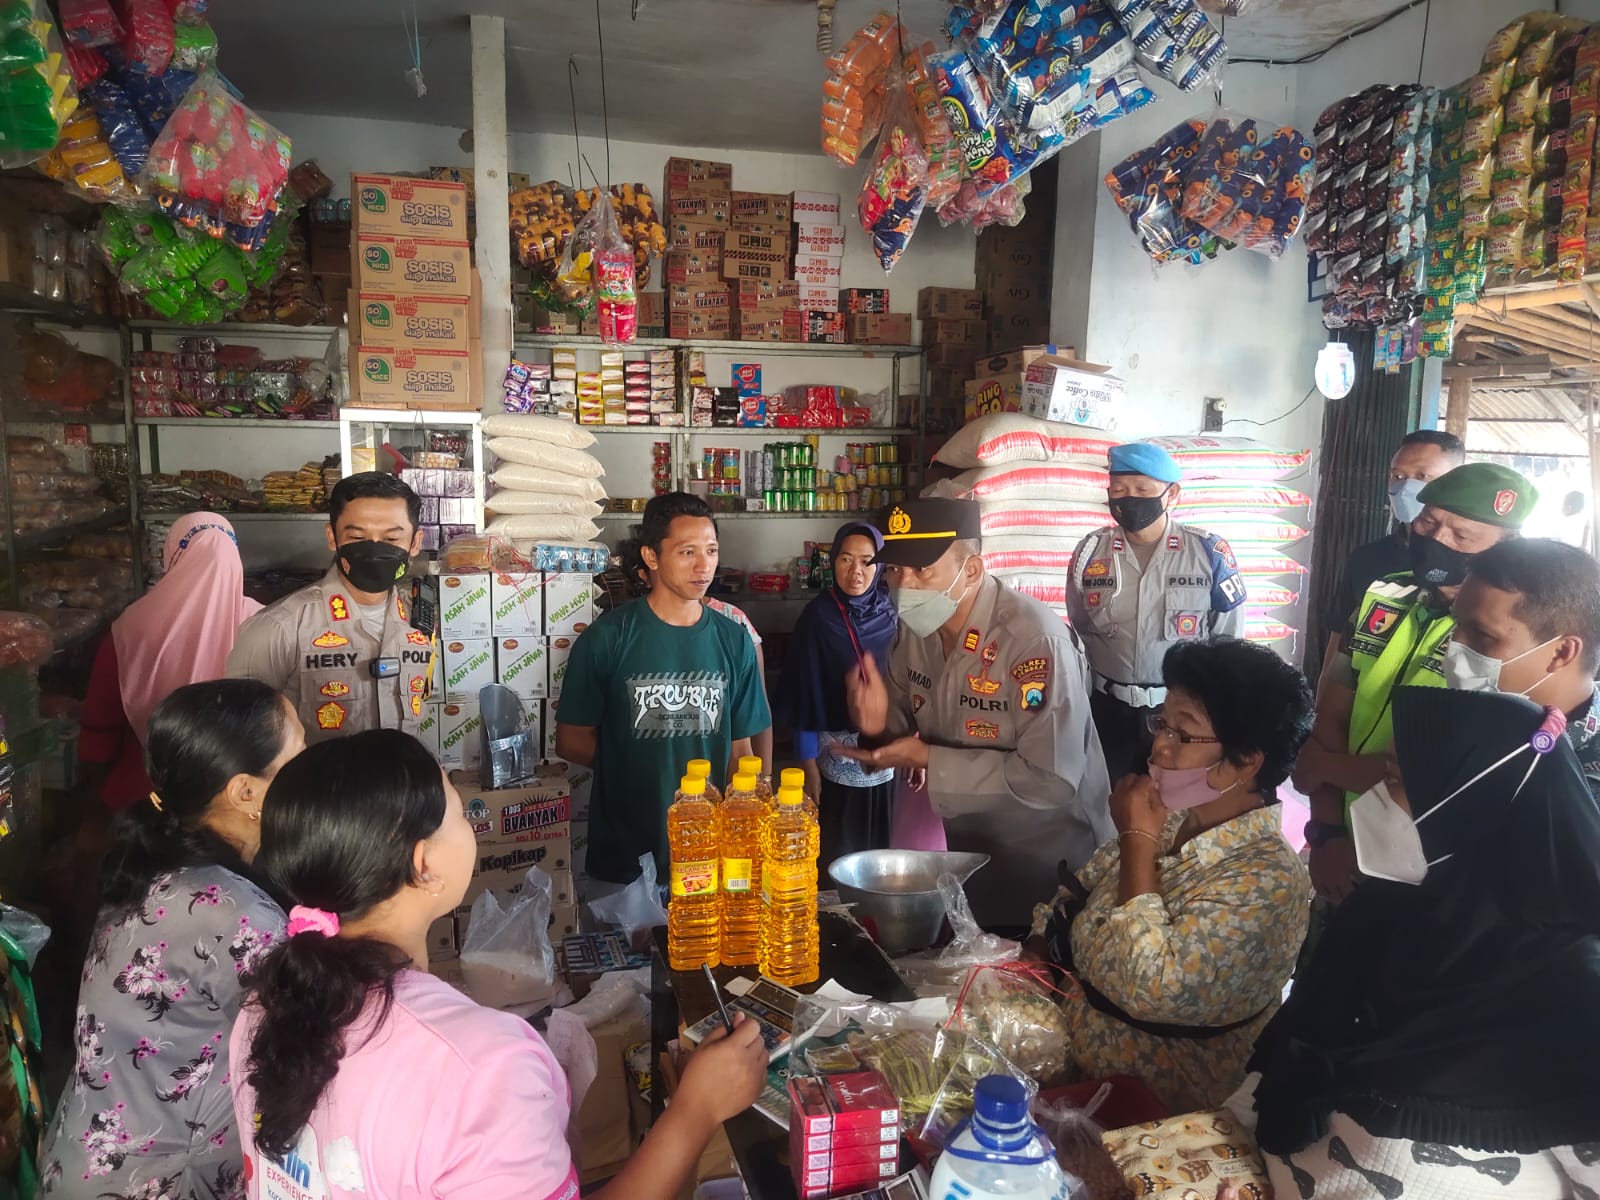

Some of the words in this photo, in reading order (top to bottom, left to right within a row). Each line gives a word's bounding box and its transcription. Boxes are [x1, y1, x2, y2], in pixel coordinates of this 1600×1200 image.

[361, 190, 377, 201] SO
[403, 202, 451, 218] SOSIS
[421, 216, 453, 227] makan
[366, 249, 380, 259] SO
[407, 260, 455, 275] SOSIS
[425, 272, 456, 283] makan
[367, 306, 380, 316] SO
[407, 317, 454, 331] SOSIS
[404, 329, 423, 339] siap
[425, 328, 456, 339] makan
[366, 360, 379, 370] SO
[406, 371, 453, 384] SOSIS
[424, 382, 455, 392] makan
[977, 383, 1000, 406] RING
[1065, 385, 1089, 398] Coffee
[980, 398, 1001, 417] GO
[1169, 577, 1209, 587] POLRI
[444, 603, 466, 623] ASAM
[466, 587, 487, 606] JAWA
[495, 600, 516, 621] ASAM
[306, 652, 358, 670] HERY
[502, 664, 523, 684] ASAM
[523, 648, 544, 668] JAWA
[1012, 659, 1046, 676] POLRES
[448, 668, 470, 688] ASAM
[469, 651, 490, 671] JAWA
[633, 684, 721, 730] TROUBLE
[960, 694, 1009, 712] POLRI
[443, 729, 465, 750] ASAM
[463, 808, 490, 820] TOP
[504, 806, 558, 834] BUANYAK
[530, 831, 541, 840] 10
[480, 846, 547, 872] Kopikap
